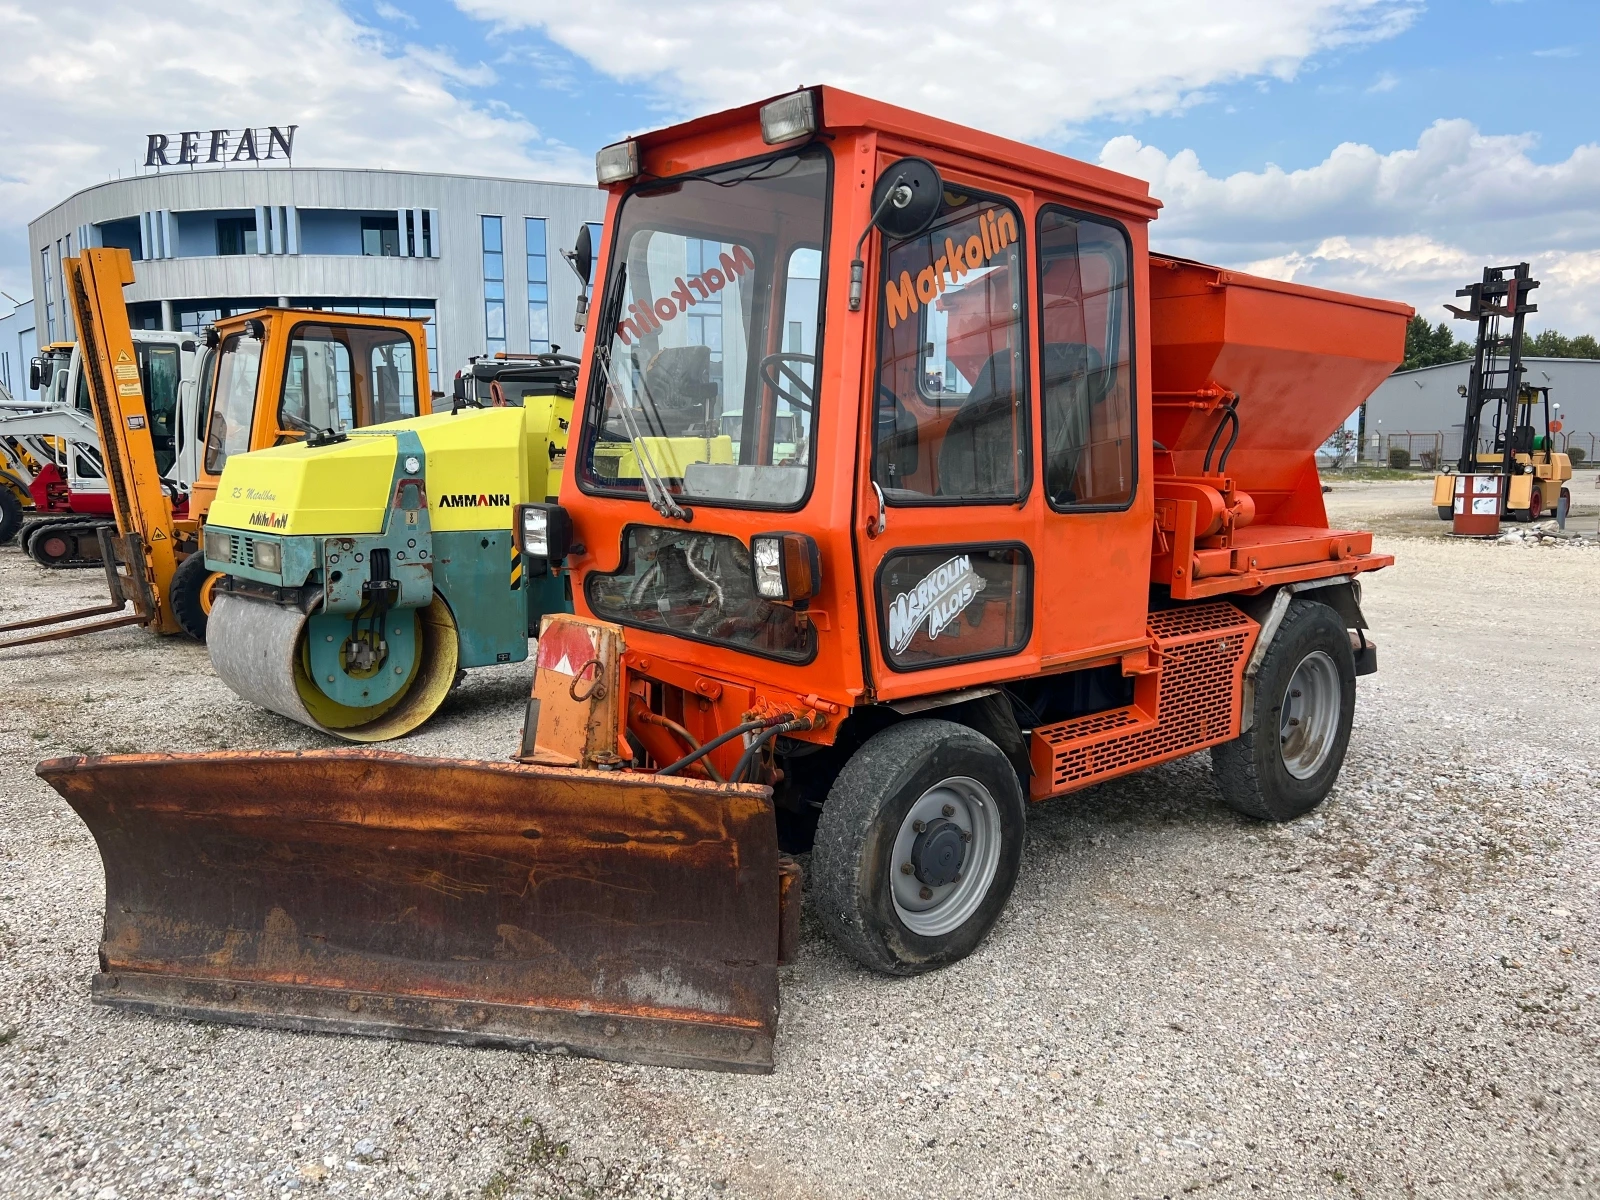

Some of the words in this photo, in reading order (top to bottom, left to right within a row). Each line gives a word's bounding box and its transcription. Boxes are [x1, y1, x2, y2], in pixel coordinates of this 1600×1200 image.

[143, 124, 299, 167] REFAN
[885, 208, 1018, 330] Markolin
[246, 487, 277, 501] Metallbau
[438, 493, 510, 508] AMMANN
[888, 554, 970, 650] MARKOLIN
[930, 582, 972, 636] ALOIS
